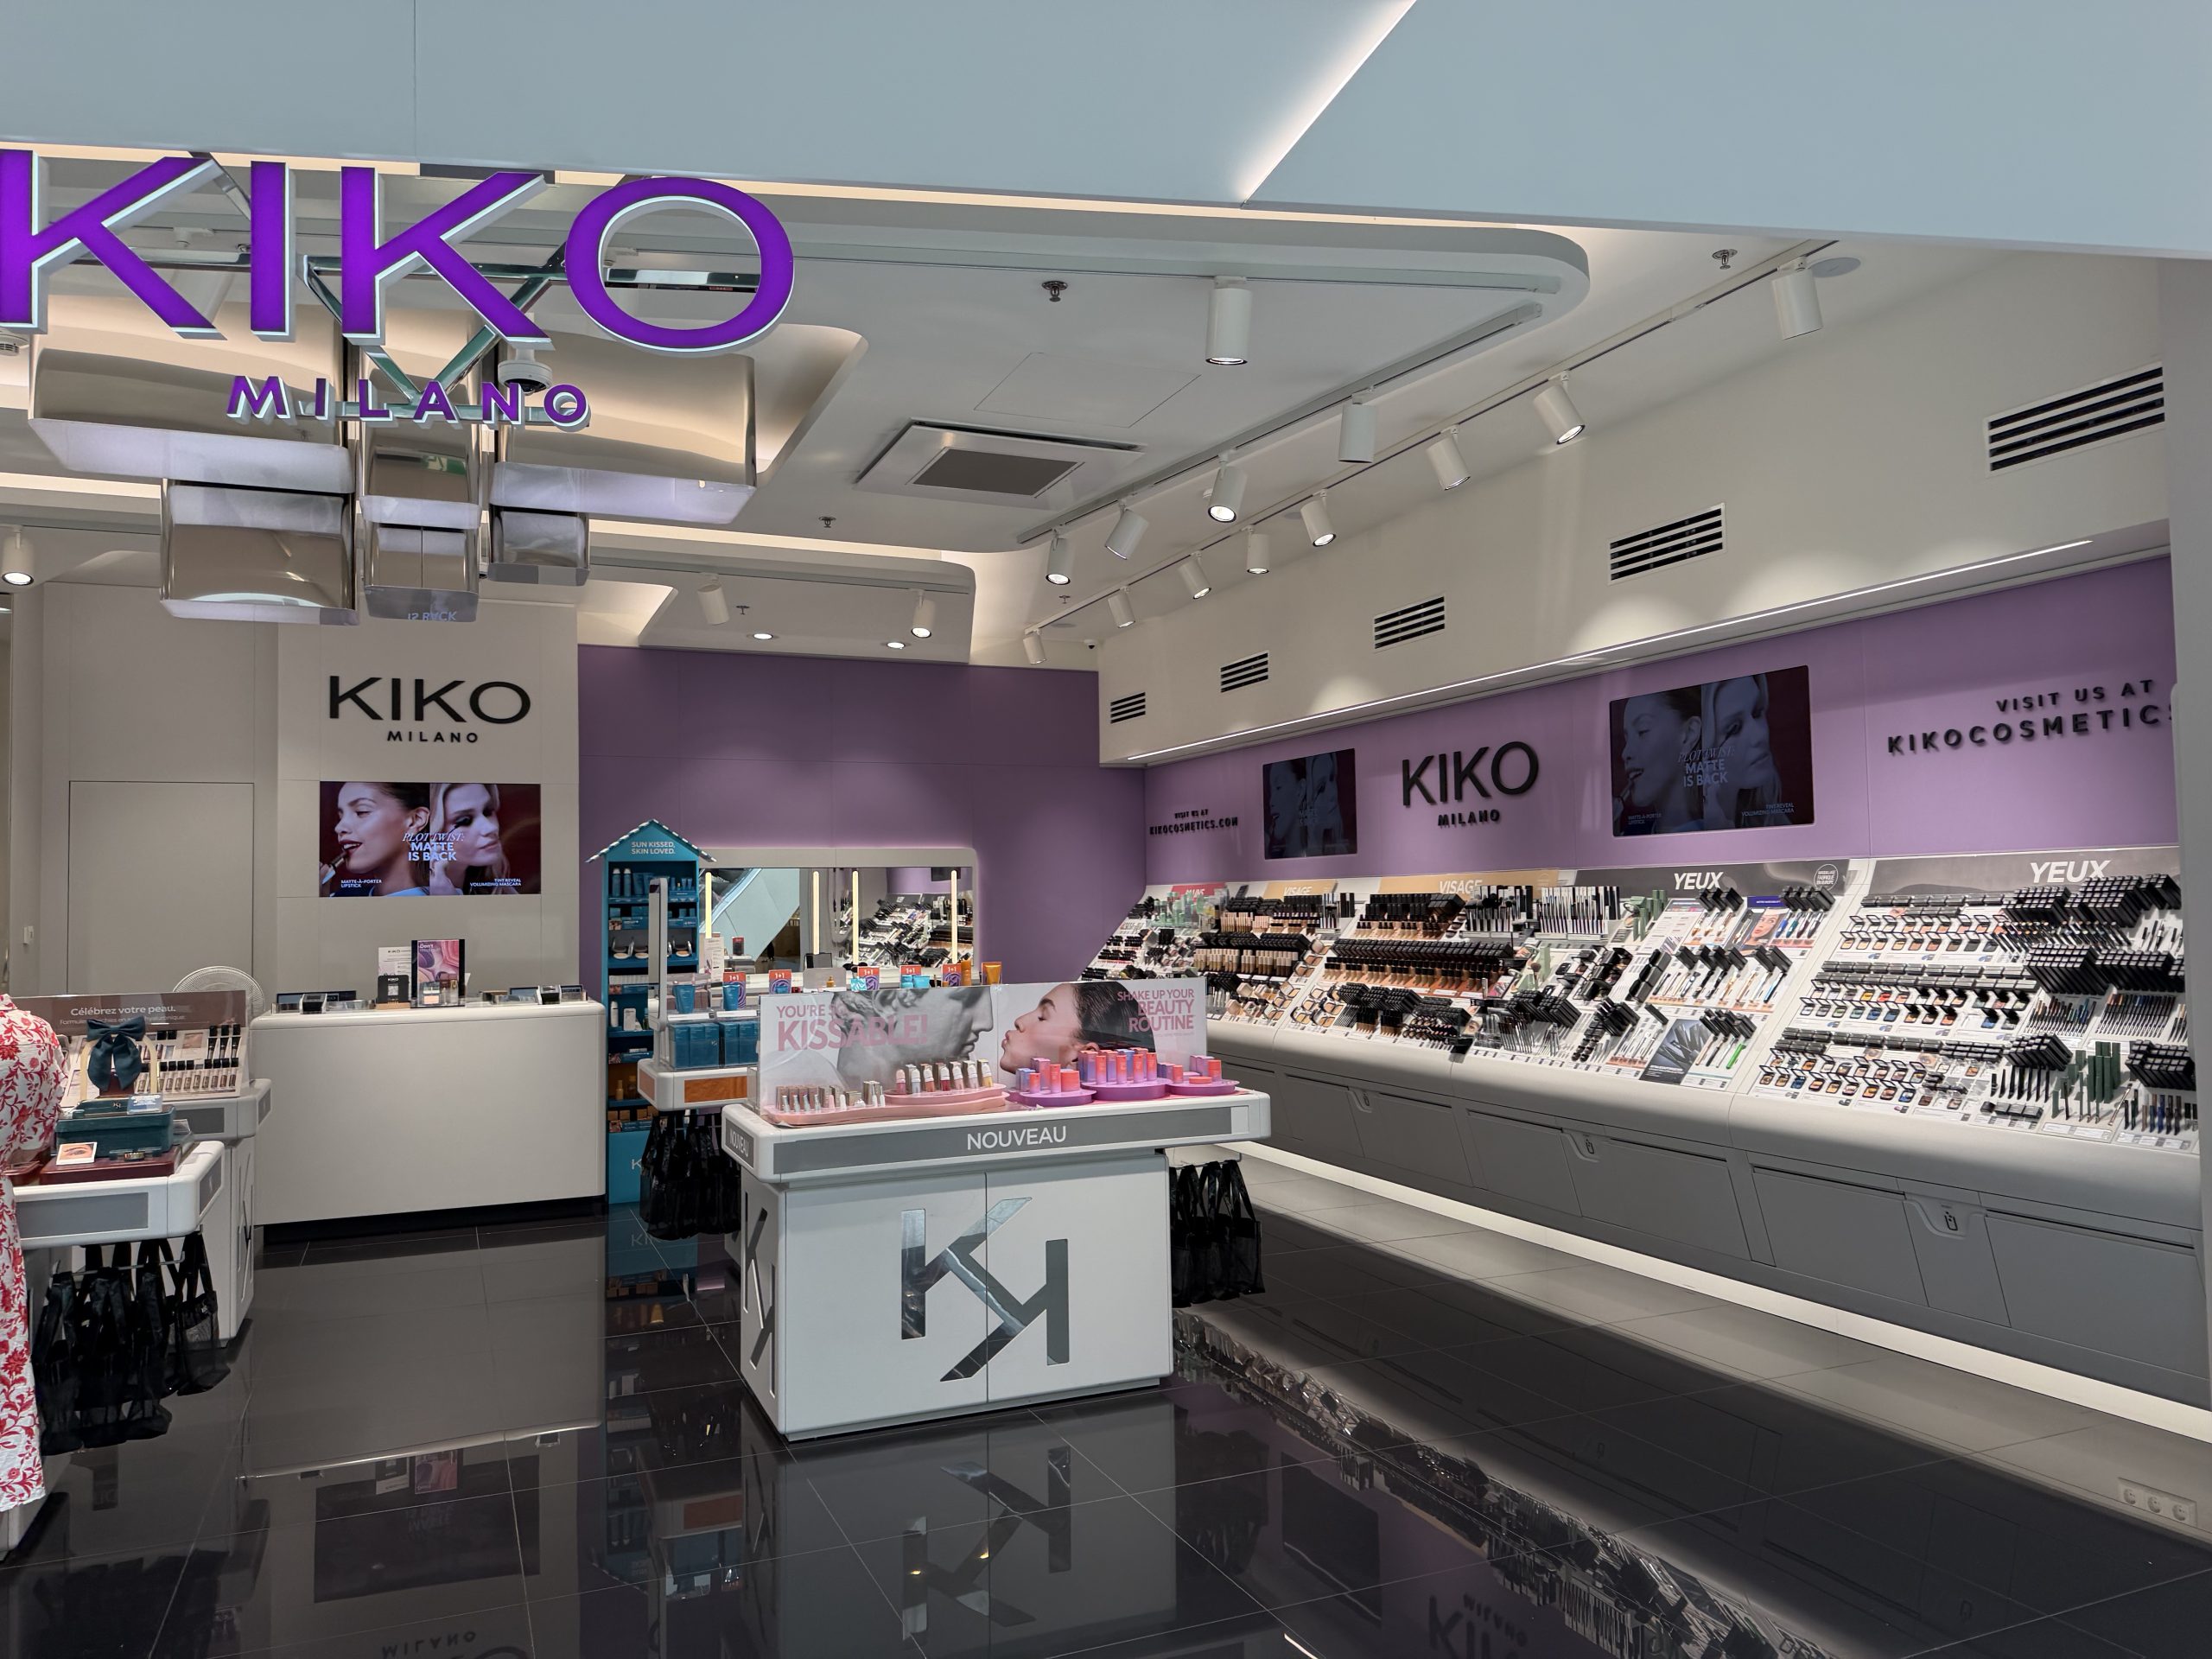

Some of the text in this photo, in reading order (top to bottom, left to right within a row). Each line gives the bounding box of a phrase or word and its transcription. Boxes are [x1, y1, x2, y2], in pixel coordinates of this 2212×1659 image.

[0, 149, 795, 356] KIKO
[227, 375, 591, 430] MILANO
[329, 675, 531, 724] KIKO
[1996, 679, 2152, 712] VISIT US AT
[386, 730, 479, 743] MILANO
[1887, 704, 2173, 754] KIKOCOSMETIC
[1402, 741, 1539, 806] KIKO
[1686, 759, 1725, 774] MATTE
[1683, 772, 1728, 787] IS BACK
[1149, 817, 1238, 836] KIKOCOSMETICS.COM
[1438, 809, 1501, 827] MILANO
[410, 842, 454, 851] MATTE
[408, 852, 457, 861] IS BACK
[1674, 871, 1724, 890] YEUX
[2031, 860, 2111, 883] YEUX
[1116, 988, 1195, 1001] SHAKE UP YOUR
[71, 1005, 175, 1016] Célébrez votre peau.
[776, 1004, 825, 1018] YOU'RE
[1137, 999, 1195, 1016] BEAUTY
[777, 1014, 928, 1052] KISSABLE!
[1128, 1014, 1195, 1033] ROUTINE
[967, 1125, 1066, 1150] NOUVEAU
